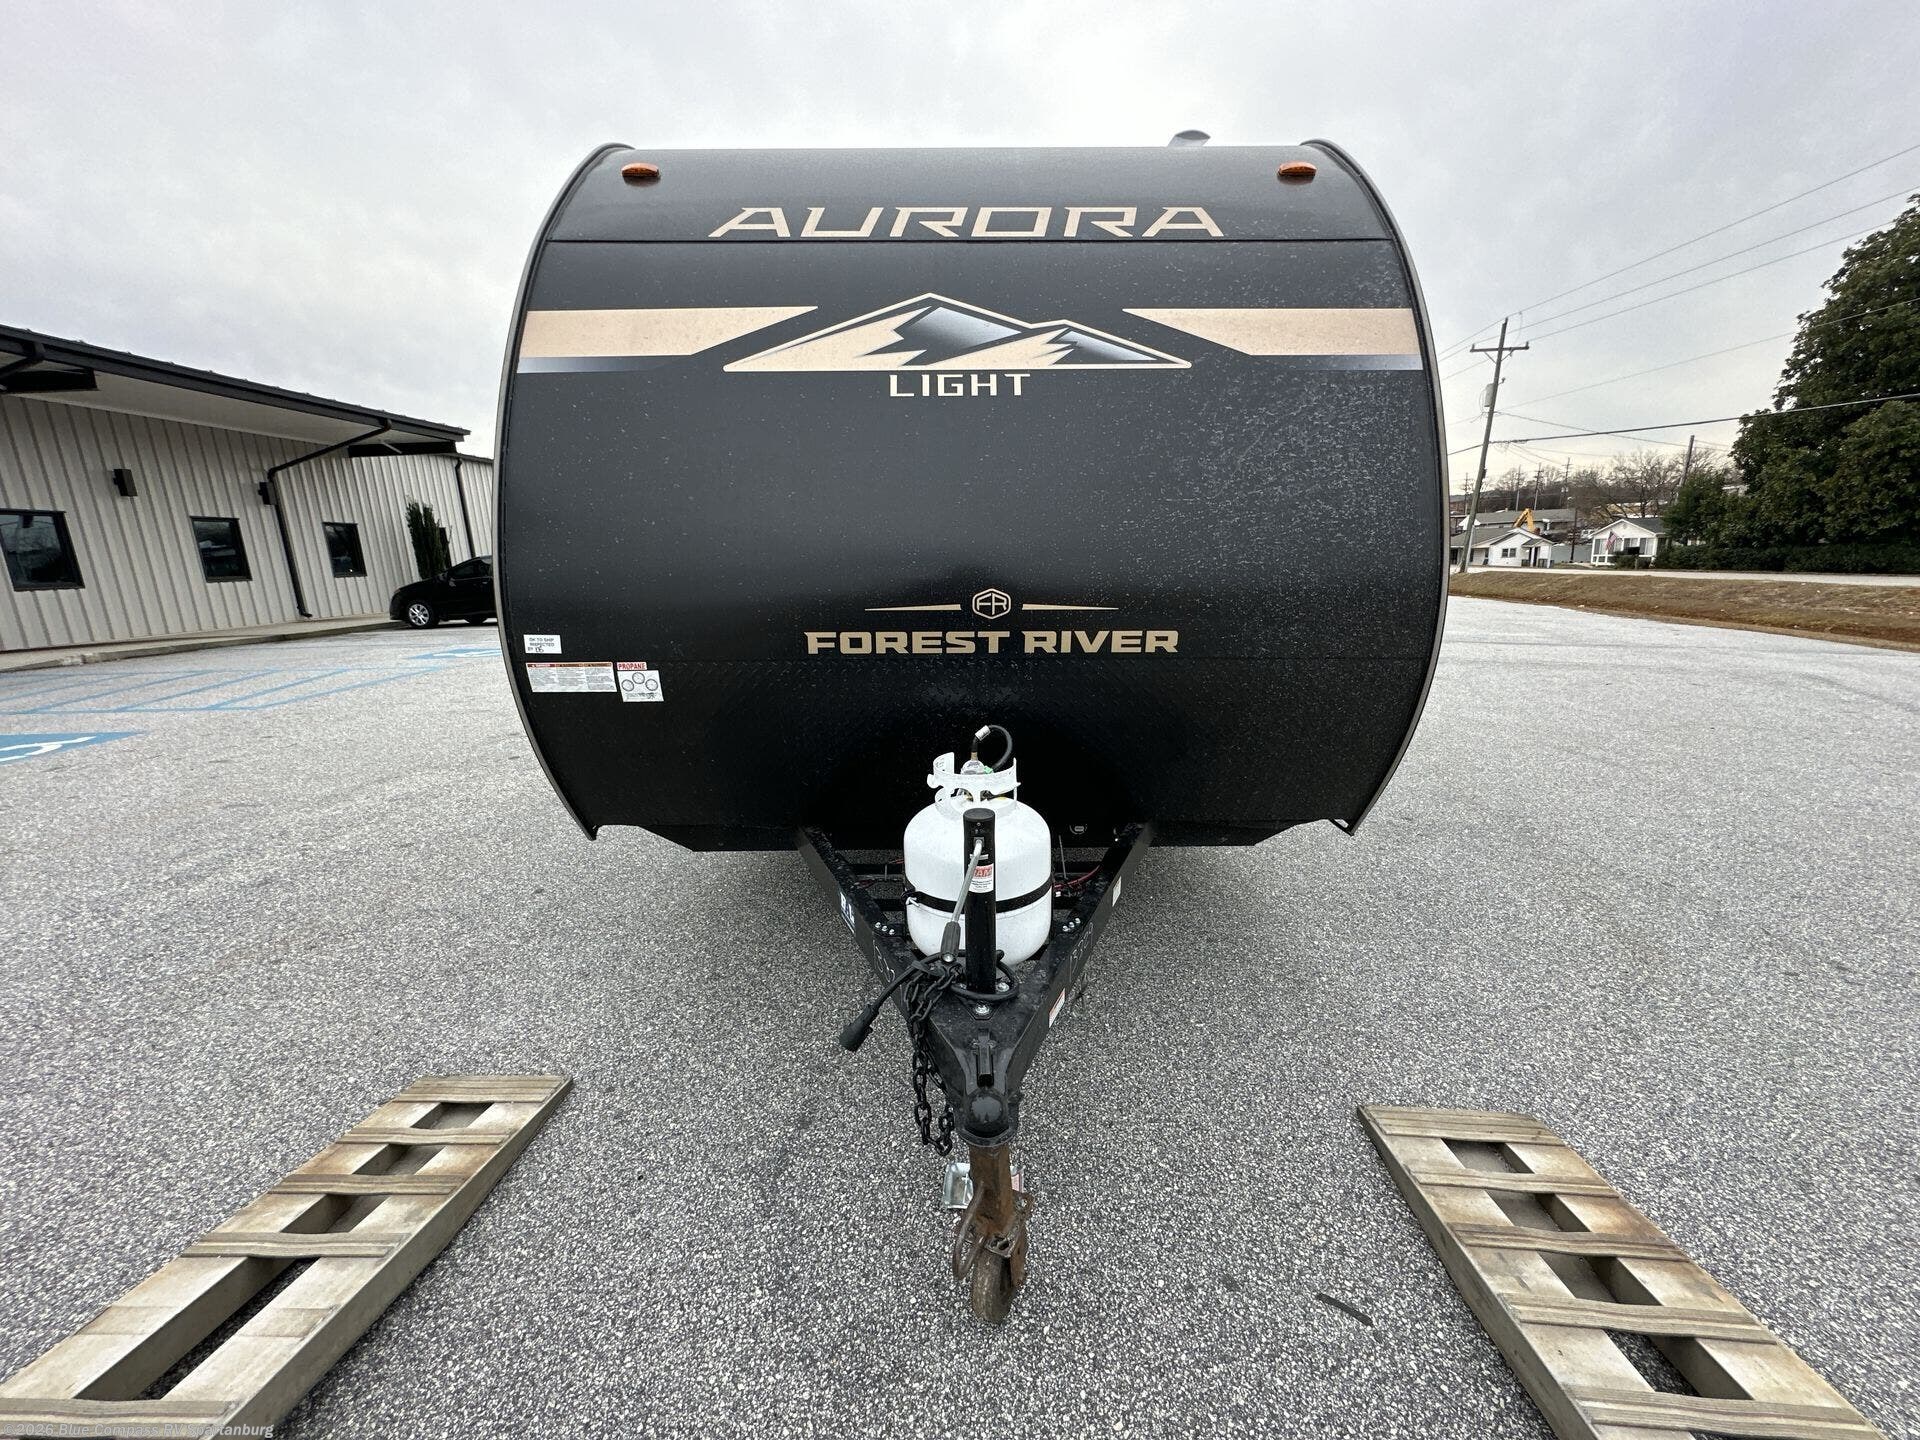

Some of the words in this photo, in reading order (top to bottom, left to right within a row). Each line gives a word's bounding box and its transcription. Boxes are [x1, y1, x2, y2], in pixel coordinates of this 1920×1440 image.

[708, 206, 1224, 238] AURORA
[888, 373, 1031, 398] LIGHT
[803, 630, 1011, 655] FOREST
[1020, 629, 1179, 654] RIVER
[618, 662, 646, 670] PROPANE
